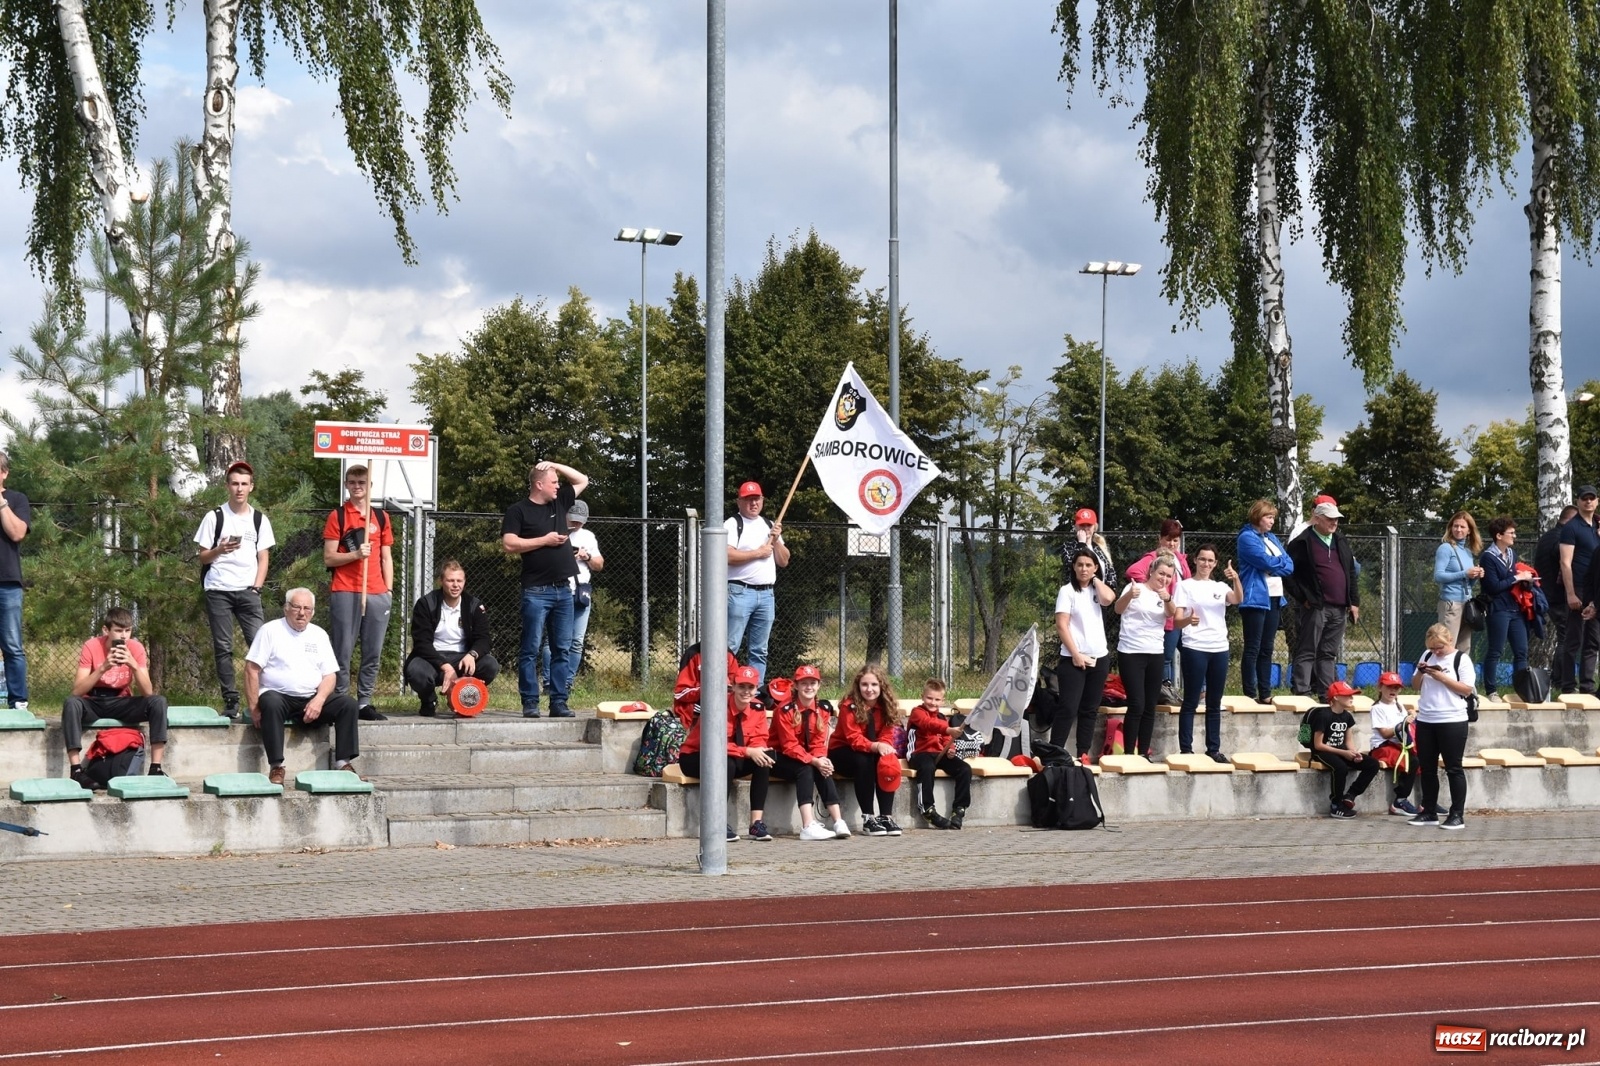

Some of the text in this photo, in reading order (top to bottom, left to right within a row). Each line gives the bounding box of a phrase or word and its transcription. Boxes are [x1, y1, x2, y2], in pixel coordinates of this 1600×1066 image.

[341, 429, 400, 439] OCHOTNICZA STRAŻ
[356, 437, 385, 445] POŻARNA
[346, 445, 402, 453] SAMBOROWICACH
[814, 440, 930, 471] SAMBOROWICE
